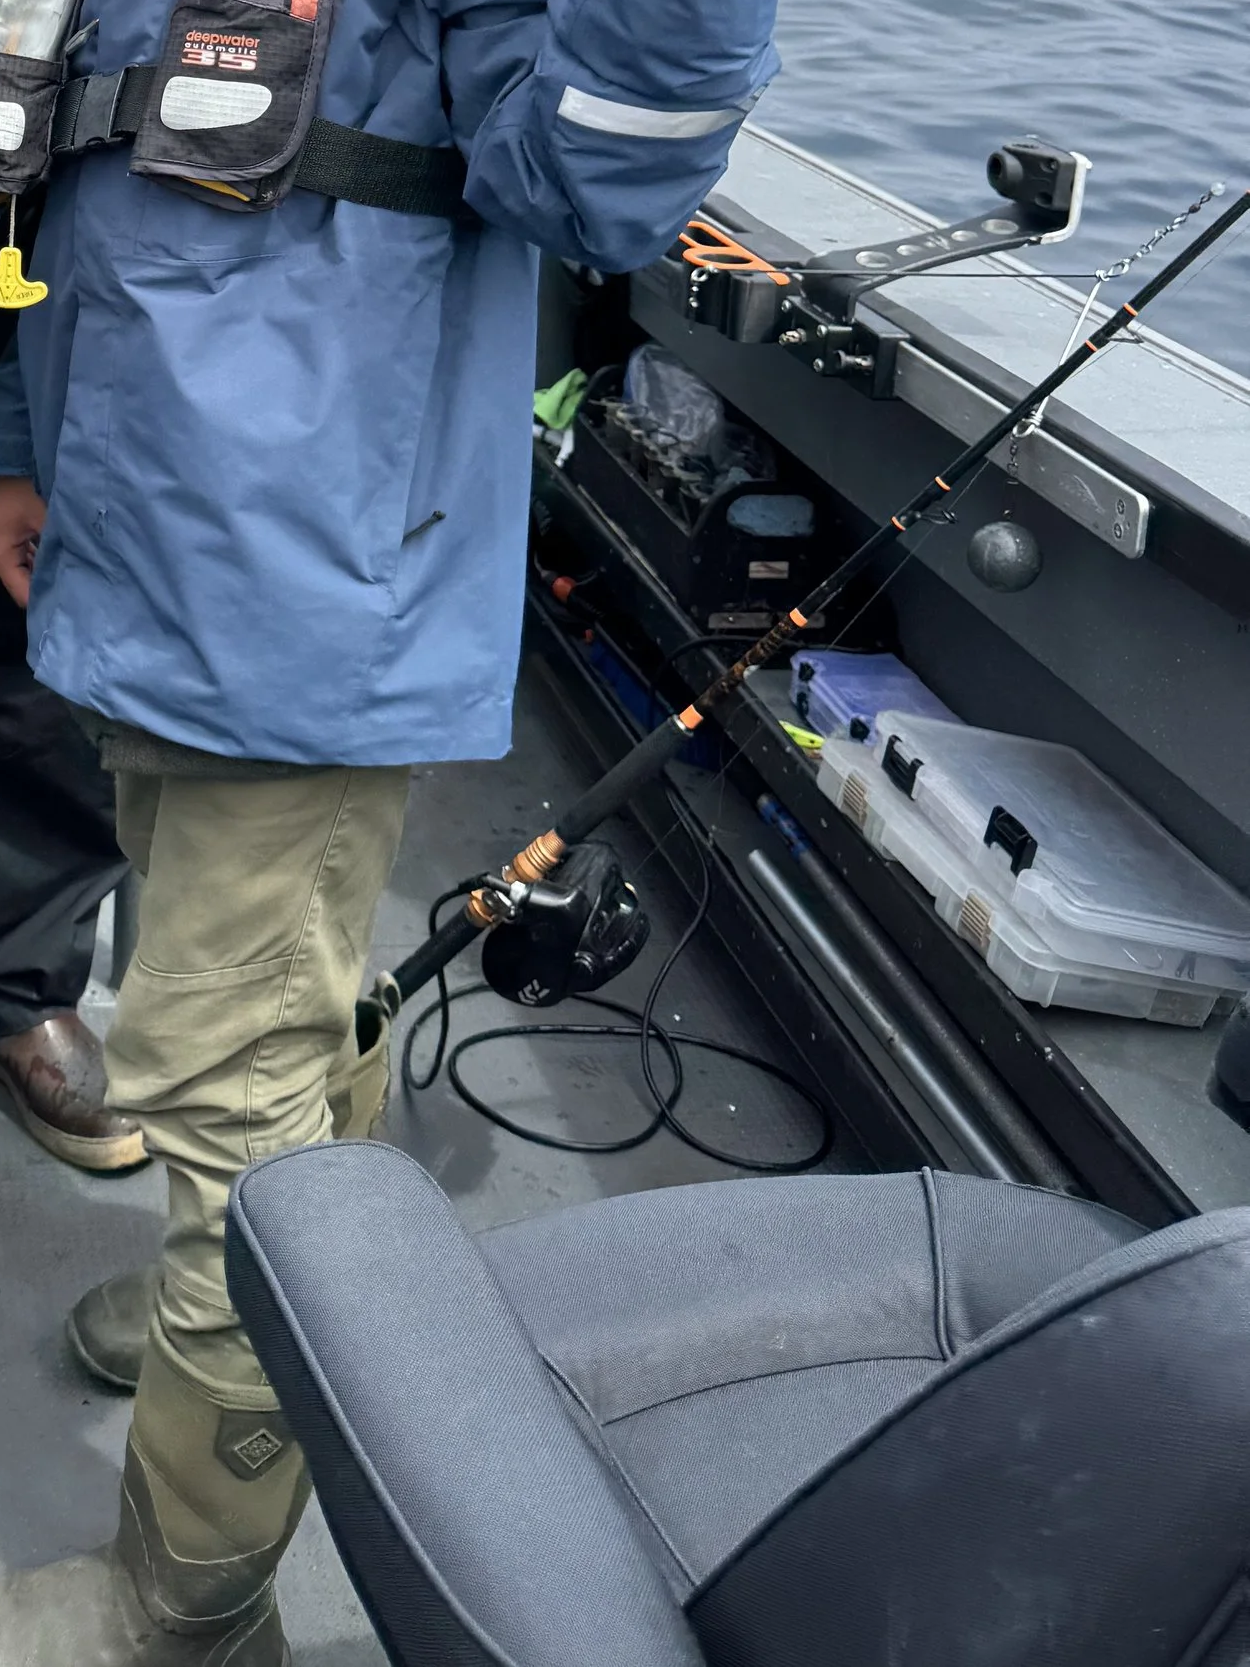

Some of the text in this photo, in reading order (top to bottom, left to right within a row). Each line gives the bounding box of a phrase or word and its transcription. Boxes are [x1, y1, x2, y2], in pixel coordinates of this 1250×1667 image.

[186, 30, 260, 48] deepwater
[184, 42, 257, 56] automatic
[181, 48, 258, 72] 35
